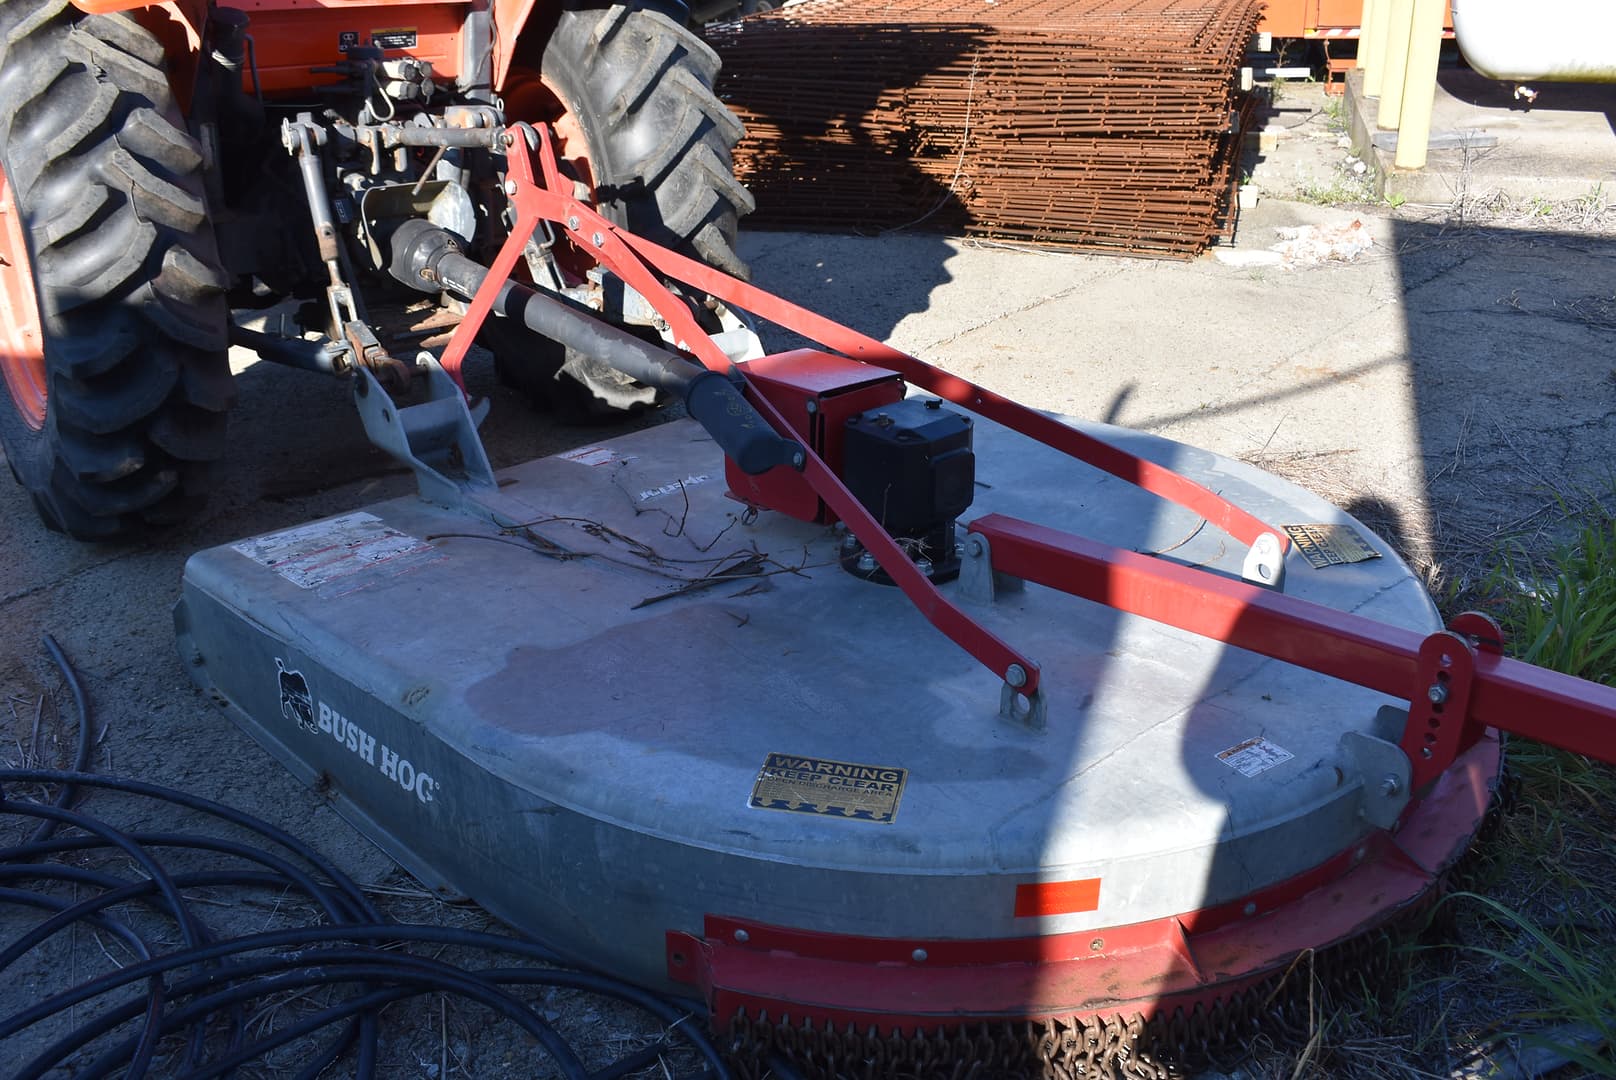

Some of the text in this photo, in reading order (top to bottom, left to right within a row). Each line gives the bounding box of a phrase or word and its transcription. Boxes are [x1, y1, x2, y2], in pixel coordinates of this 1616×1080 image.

[1287, 525, 1329, 567] WARNING
[318, 700, 376, 766] BUSH
[769, 767, 894, 791] KEEP CLEAR
[774, 756, 898, 783] WARNING
